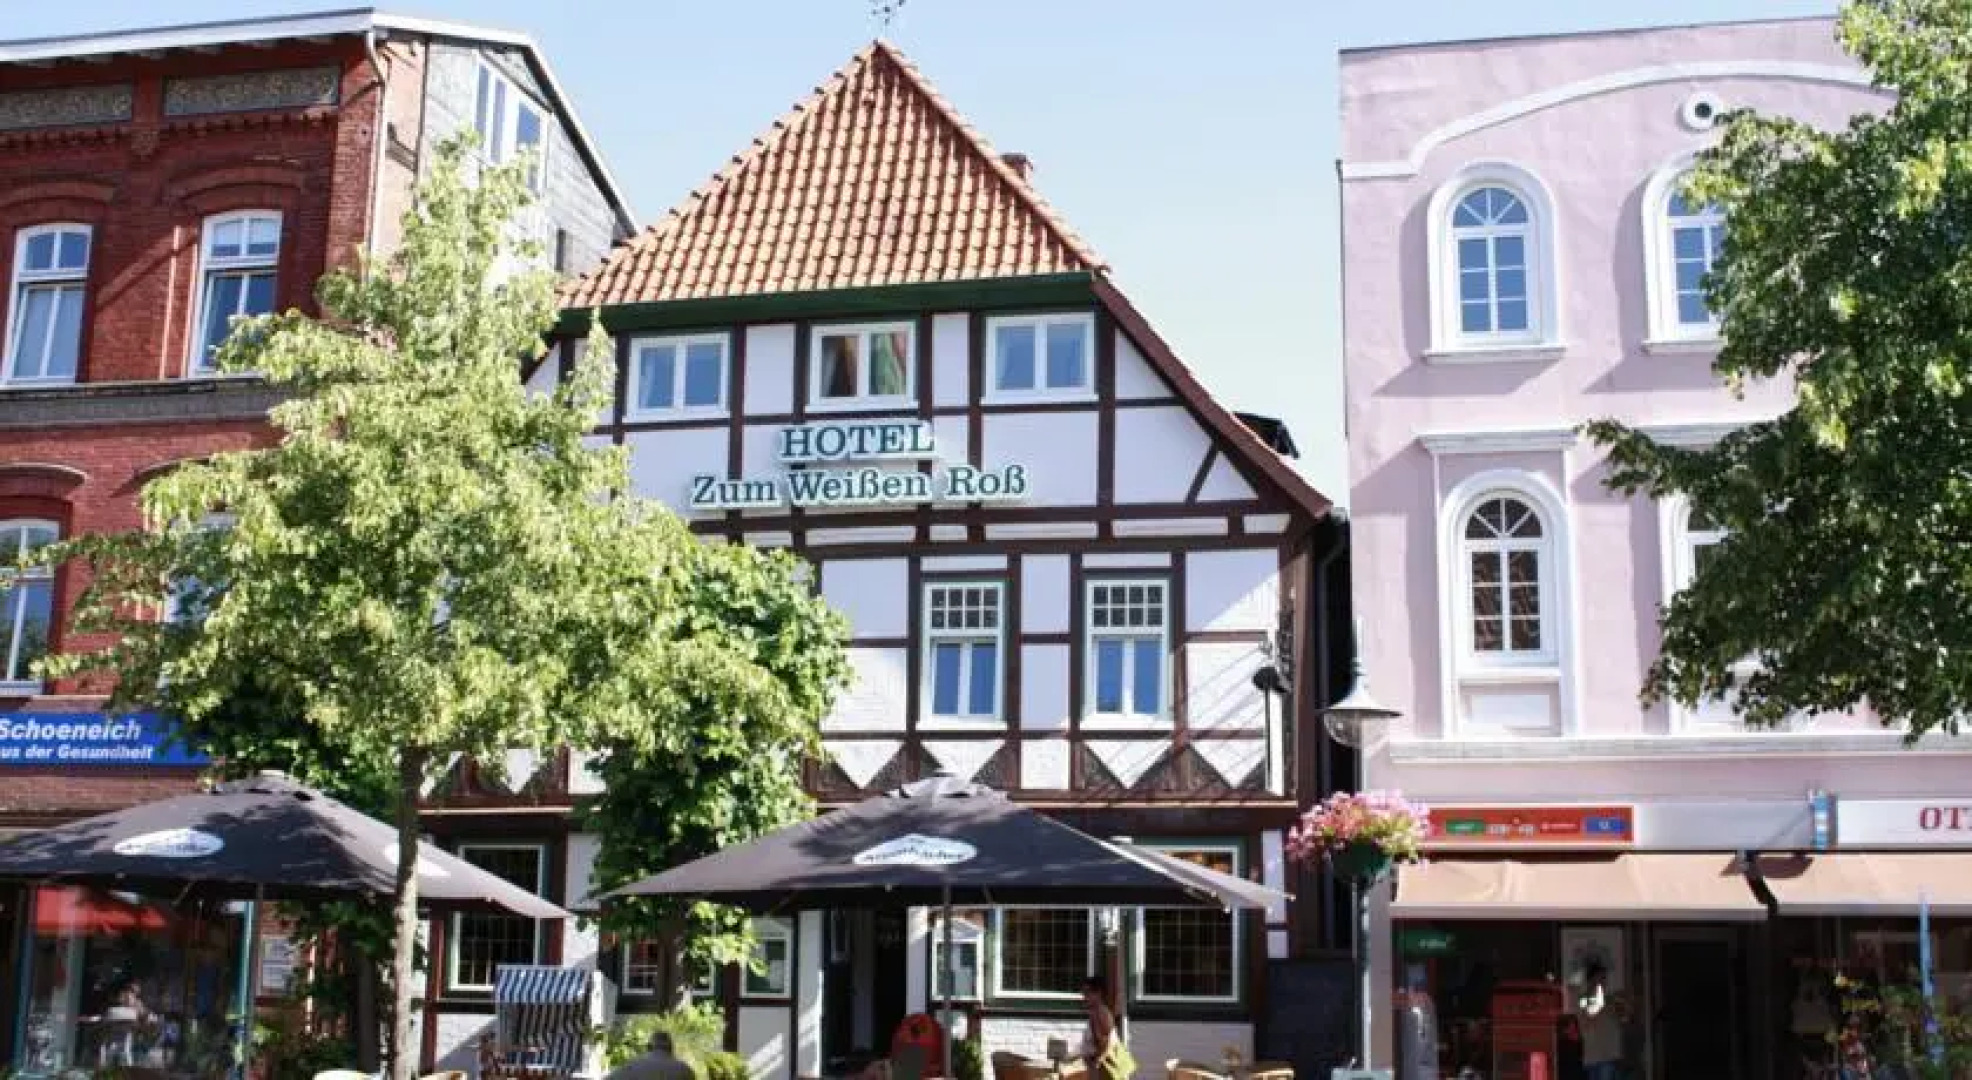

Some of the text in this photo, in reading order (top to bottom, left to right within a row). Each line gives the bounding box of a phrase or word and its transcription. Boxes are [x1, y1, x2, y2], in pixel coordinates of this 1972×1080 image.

[781, 424, 935, 457] HOTEL
[692, 464, 1026, 505] Zum Weißen Roß
[0, 717, 142, 741] Schoeneich
[25, 744, 54, 759] der
[58, 743, 153, 760] Gesundheit
